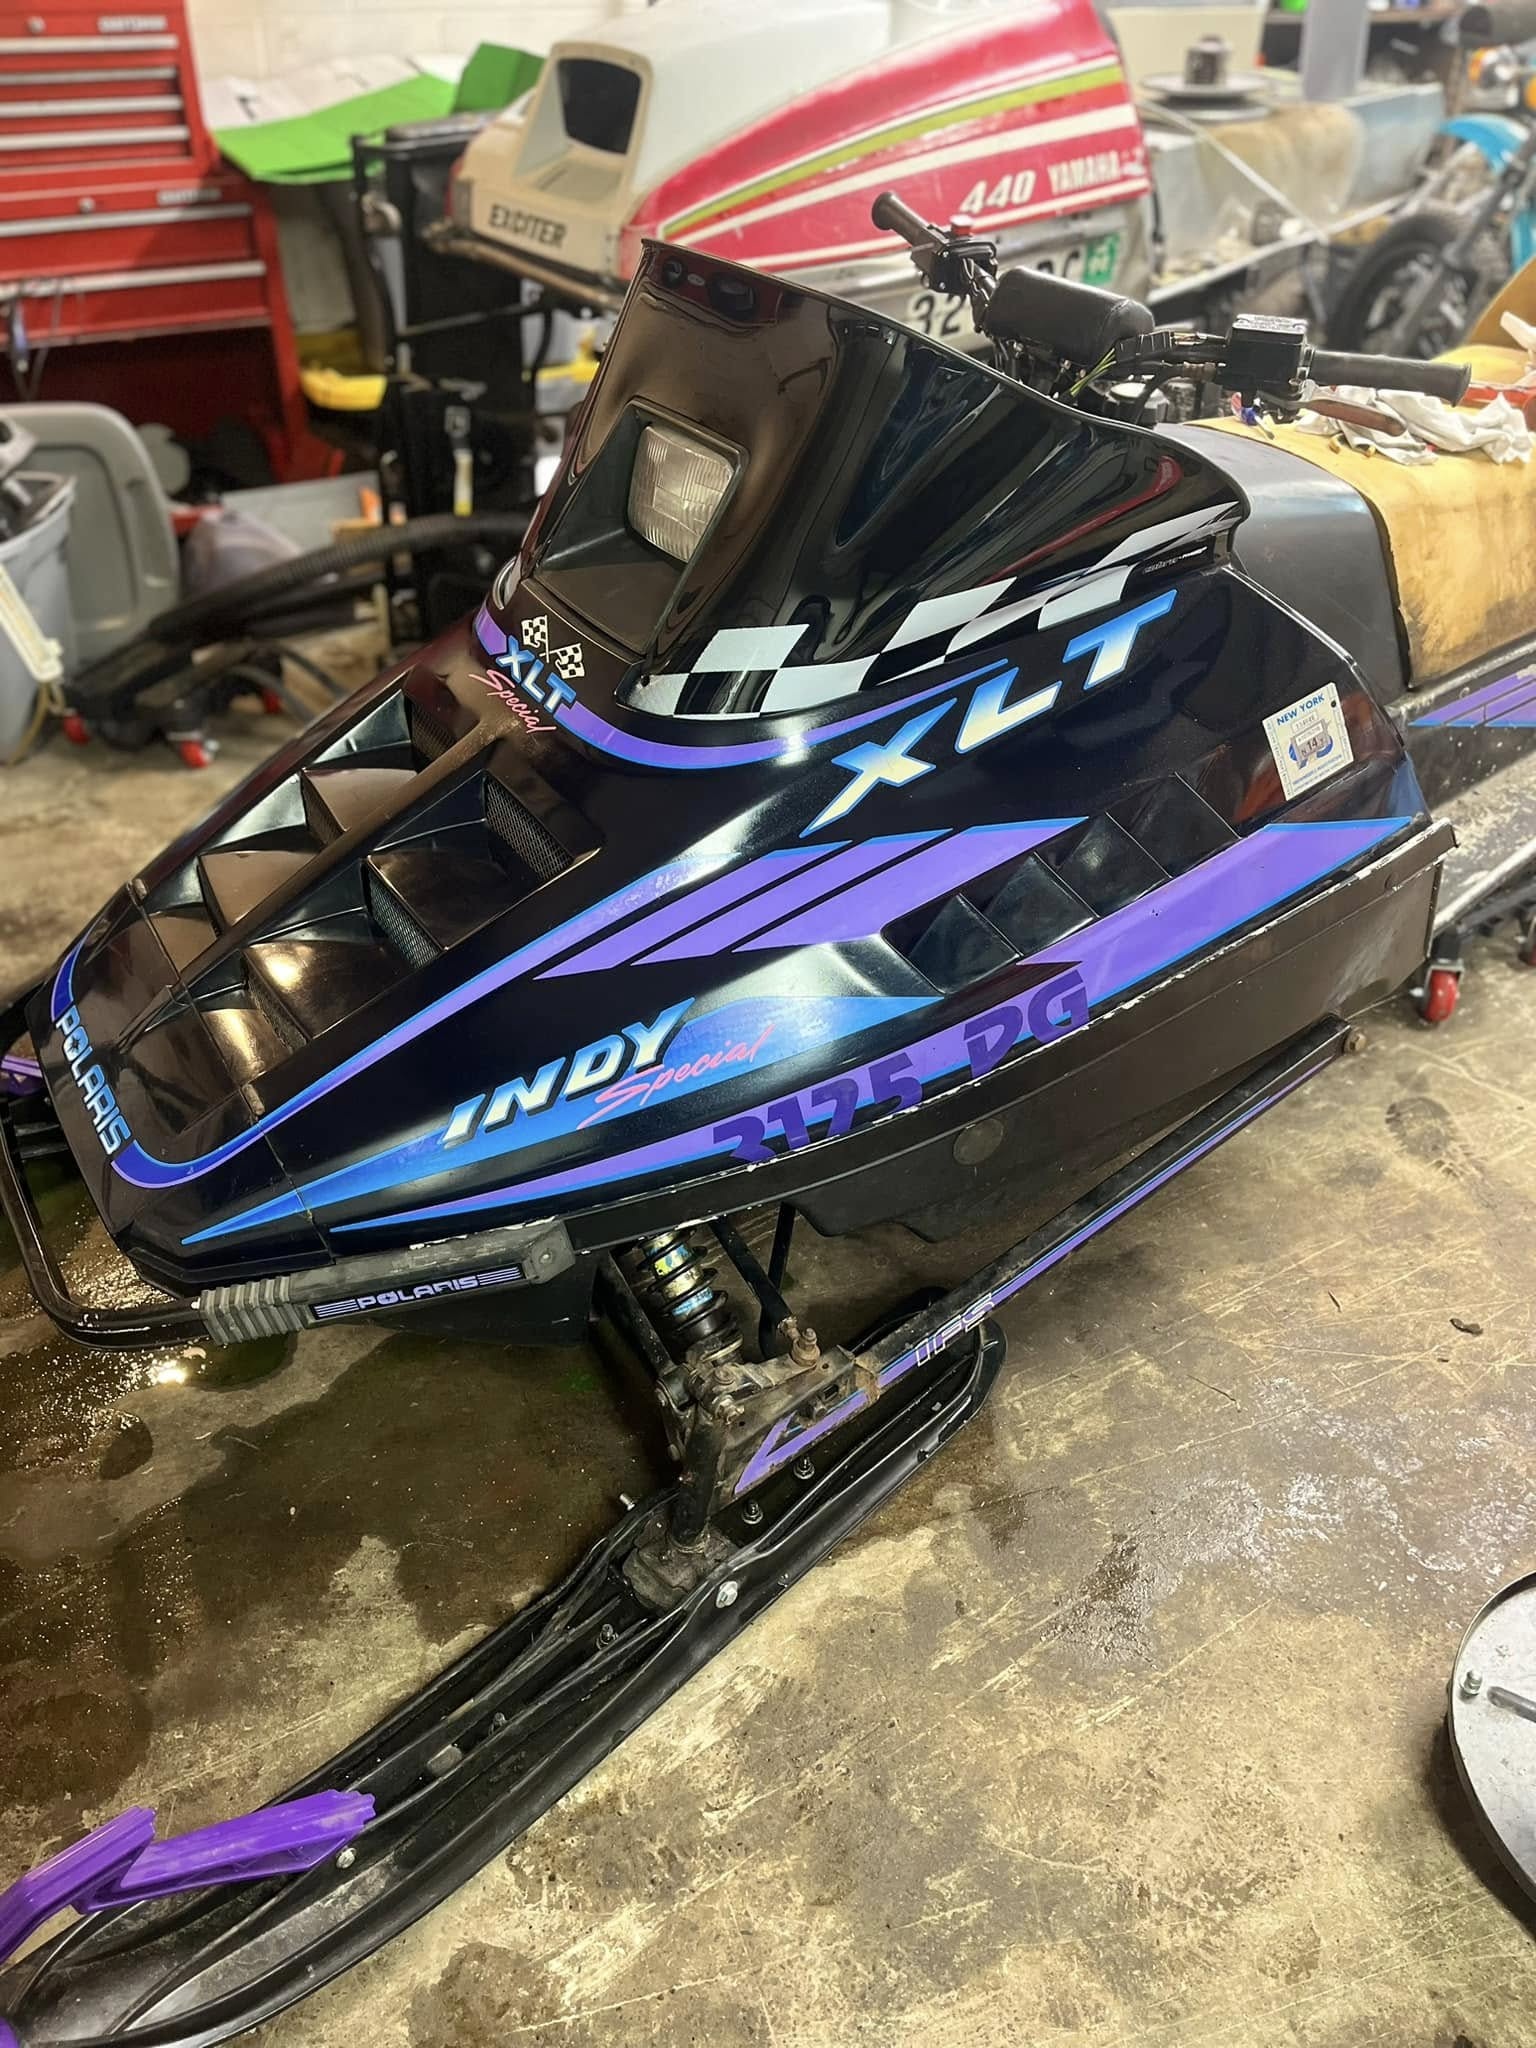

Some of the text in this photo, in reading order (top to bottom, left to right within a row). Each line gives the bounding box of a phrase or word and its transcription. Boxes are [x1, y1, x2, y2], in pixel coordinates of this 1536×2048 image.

[958, 149, 1121, 215] 440 YAMAHA
[488, 203, 567, 248] EXCITER
[467, 668, 558, 735] Special
[495, 634, 577, 714] XLT
[1276, 708, 1298, 726] NEW
[1299, 692, 1325, 712] YORK
[799, 587, 1178, 840] XLT
[55, 1004, 132, 1156] POLARIS
[437, 996, 697, 1150] INDY
[575, 1023, 777, 1131] Special
[356, 1275, 480, 1310] POLARIS
